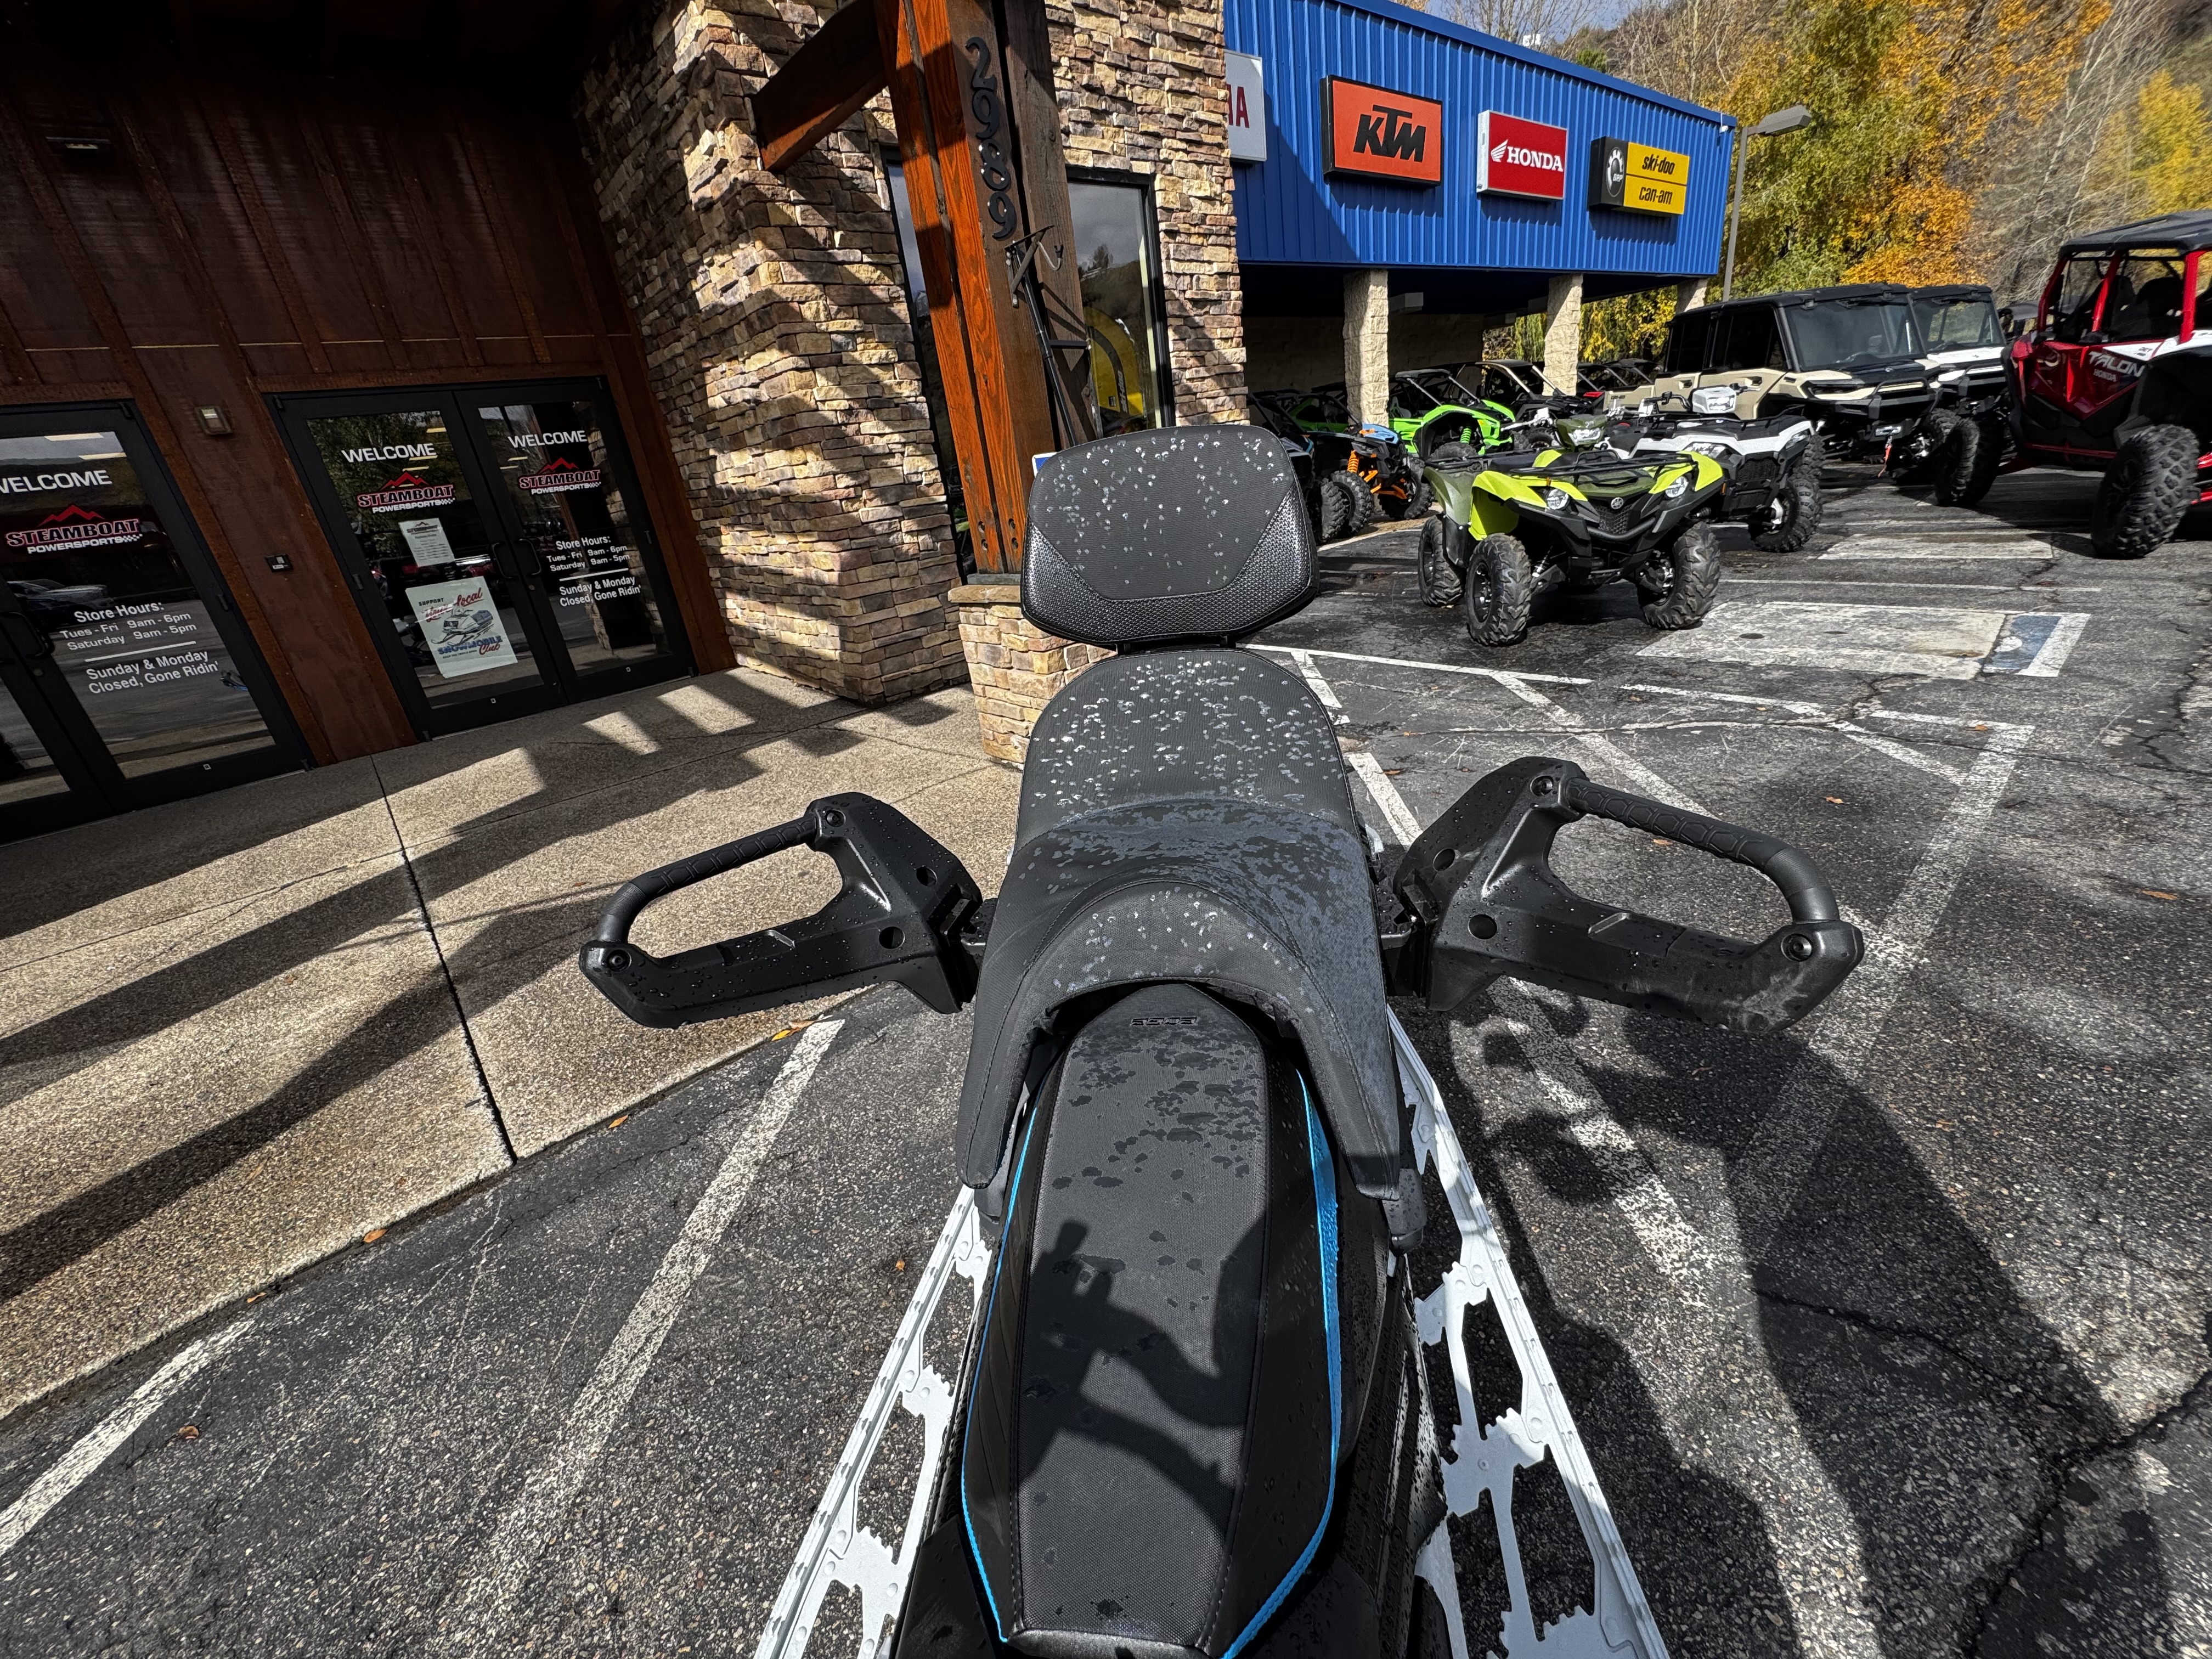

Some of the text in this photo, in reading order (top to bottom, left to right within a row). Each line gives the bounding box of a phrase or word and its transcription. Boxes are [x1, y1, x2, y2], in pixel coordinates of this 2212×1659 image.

[964, 36, 1017, 240] 2989
[1353, 104, 1426, 163] KTM
[1507, 146, 1564, 172] HONDA
[1642, 154, 1675, 175] ski-doo
[1639, 187, 1673, 205] can-am
[2088, 351, 2146, 377] TALON
[2093, 369, 2117, 382] HONDA
[507, 430, 588, 448] WELCOME
[341, 443, 437, 463] WELCOME
[519, 469, 601, 489] STEAMBOAT
[531, 483, 589, 495] POWERSPORTS
[358, 484, 454, 507] STEAMBOAT
[372, 499, 441, 514] POWERSPORTS
[4, 518, 140, 547] STEAMBOAT
[27, 535, 123, 554] POWERSPORTS
[556, 536, 611, 550] Store Hours:
[571, 551, 583, 559] Fri
[610, 545, 627, 554] 6pm
[550, 561, 585, 572] Saturday
[559, 576, 635, 595] Sunday & Monday
[560, 584, 641, 607] Closed, Gone Ridin'
[419, 597, 444, 606] SUPPORT
[74, 602, 165, 623] Store Hours:
[59, 629, 93, 639] Tues
[100, 623, 119, 633] Fri
[127, 618, 156, 629] 9am
[163, 613, 191, 623] 6pm
[67, 635, 125, 651] Saturday
[133, 630, 161, 640] 9am
[169, 624, 197, 634] 5pm
[437, 635, 503, 654] SNOWMOBILE
[479, 642, 501, 655] Club
[86, 651, 208, 680] Sunday & Monday
[88, 661, 219, 694] Closed, Gone Ridin'
